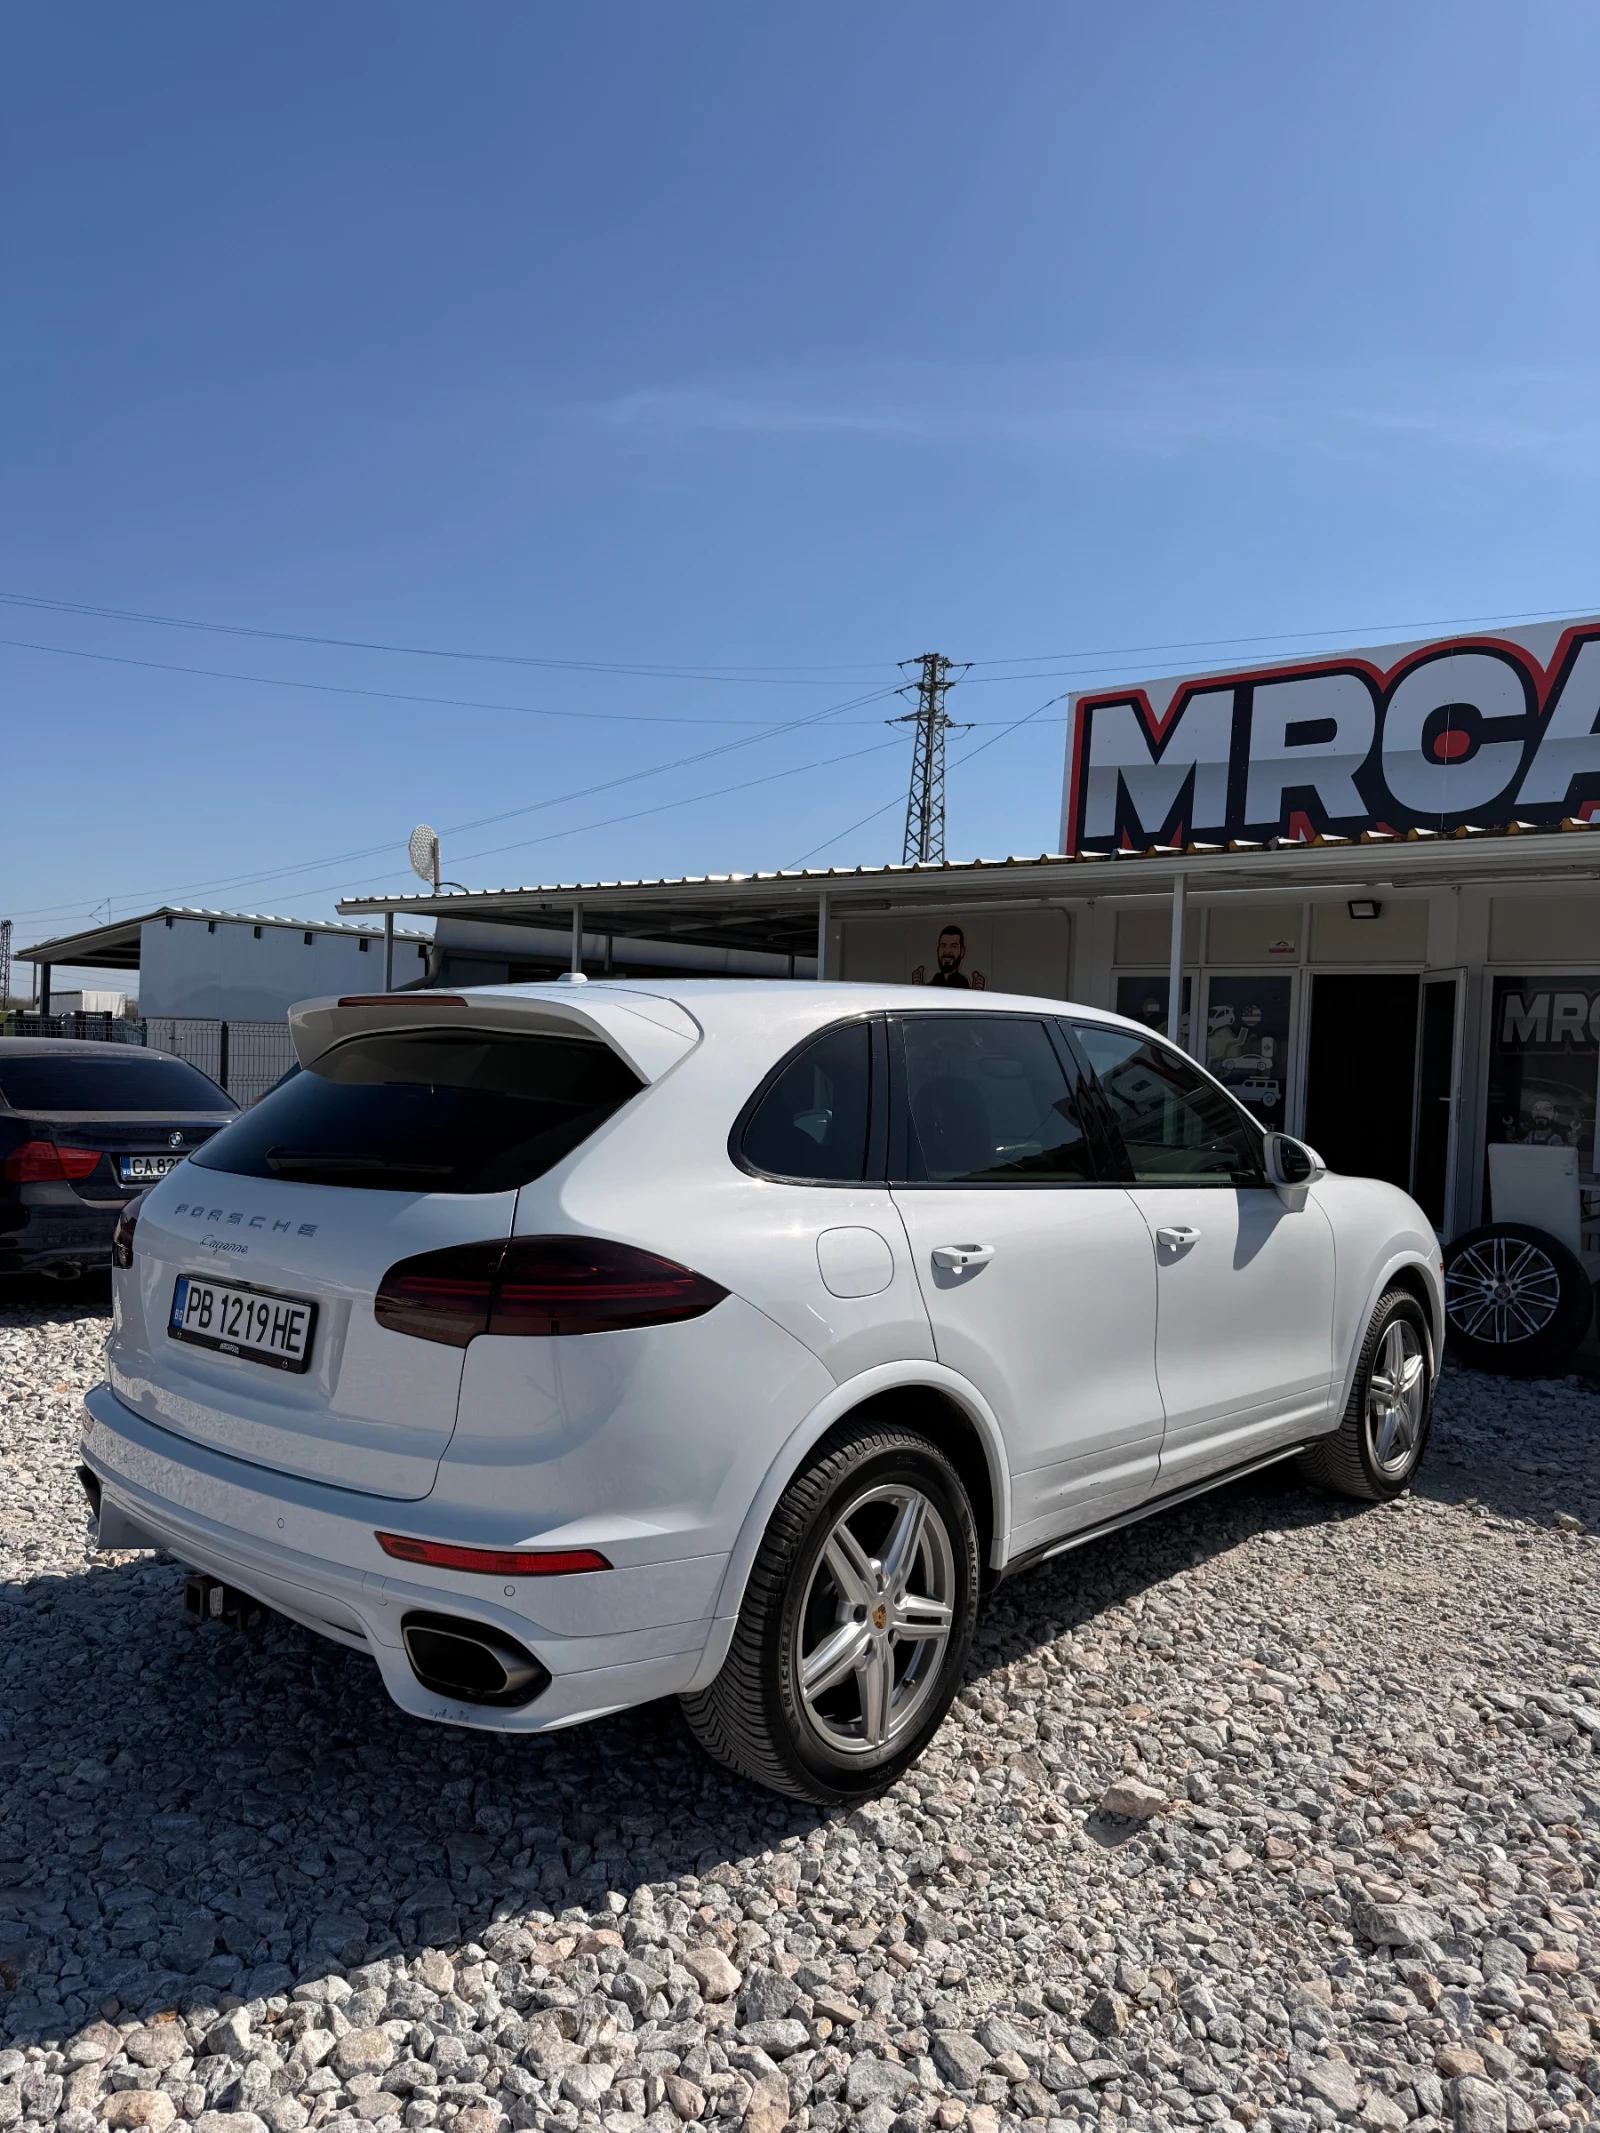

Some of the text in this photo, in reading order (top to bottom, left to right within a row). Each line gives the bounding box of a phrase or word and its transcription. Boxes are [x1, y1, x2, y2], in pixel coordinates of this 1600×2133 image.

[132, 1159, 153, 1174] CA
[157, 1158, 183, 1174] 82
[174, 1203, 319, 1238] PORSCHE
[200, 1234, 249, 1255] Cayenne
[174, 1286, 305, 1353] BG PB 1219 HE
[780, 1602, 795, 1707] MICHELIN
